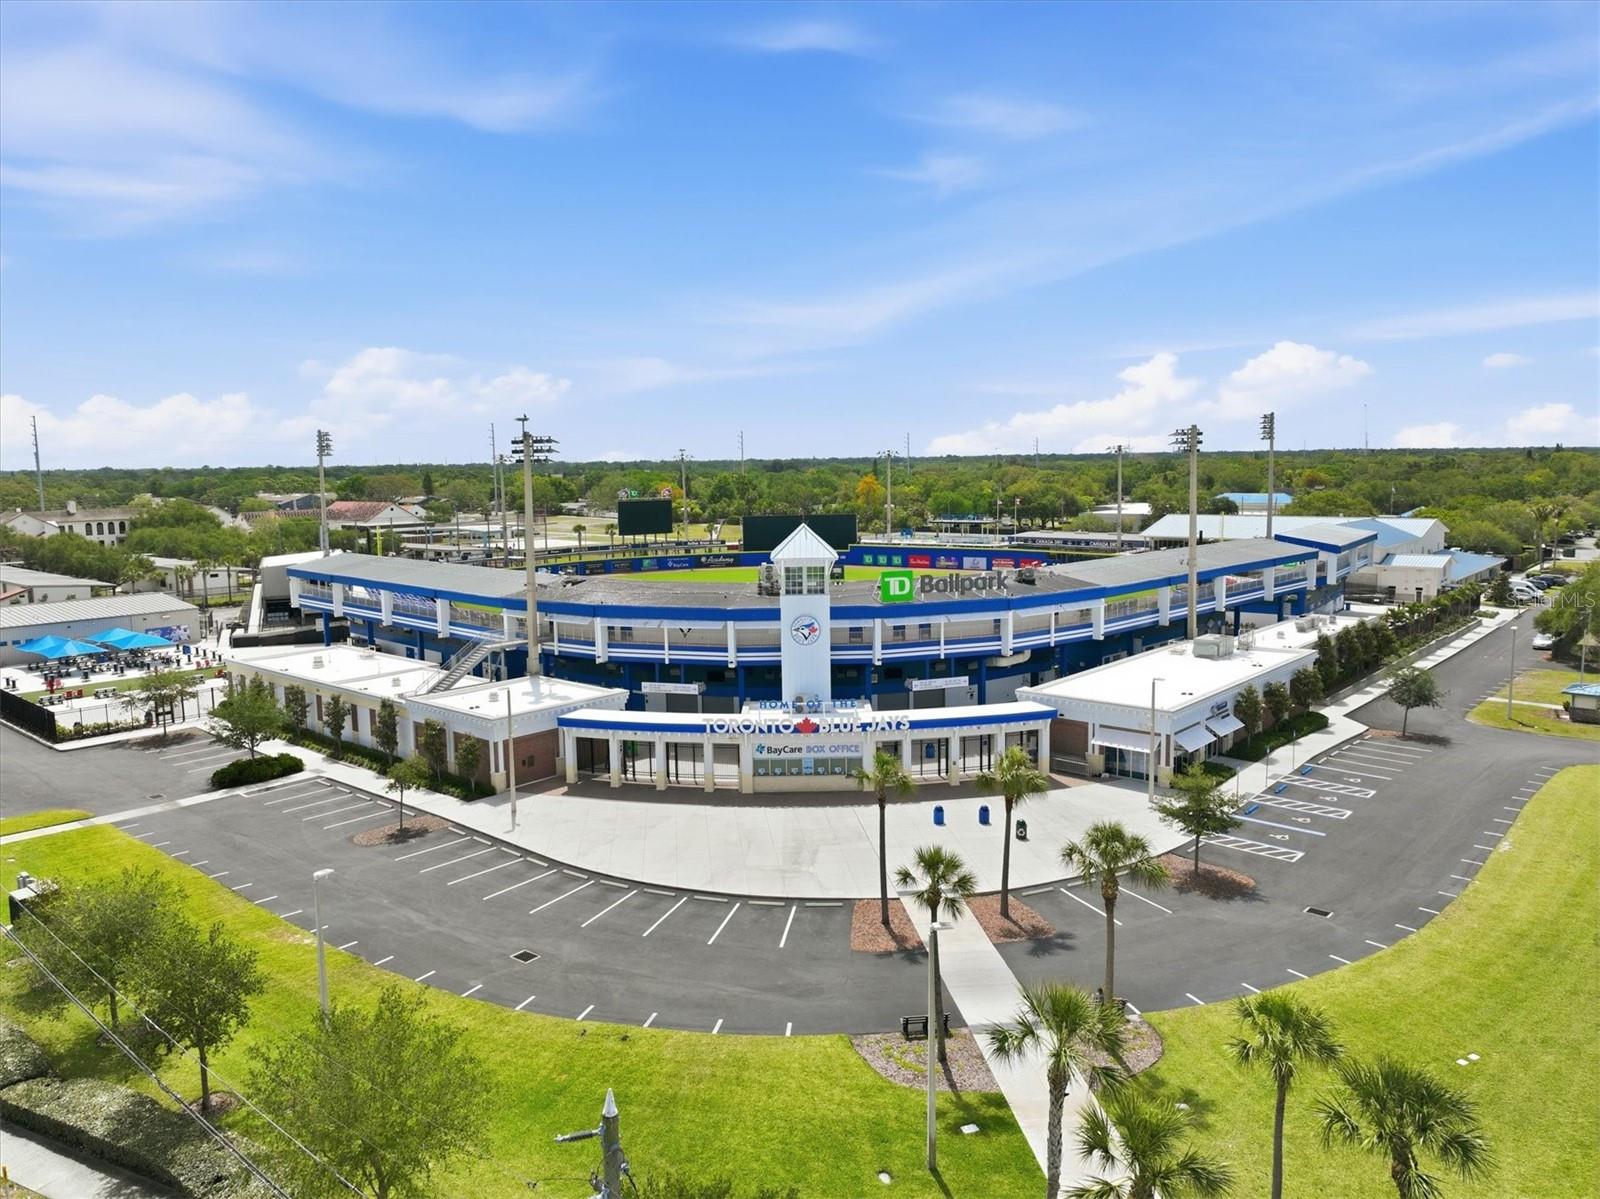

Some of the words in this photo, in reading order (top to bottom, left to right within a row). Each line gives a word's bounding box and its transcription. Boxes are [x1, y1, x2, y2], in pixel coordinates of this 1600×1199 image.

[884, 577, 911, 596] TD
[920, 570, 1009, 595] Ballpark
[760, 700, 797, 709] HOME
[806, 700, 822, 709] OF
[832, 700, 857, 708] THE
[702, 718, 795, 733] TORONTO
[820, 716, 862, 733] BLUE
[866, 714, 910, 731] JAYS
[766, 745, 803, 756] BayCare
[806, 744, 825, 753] BOX
[829, 744, 860, 753] OFFICE
